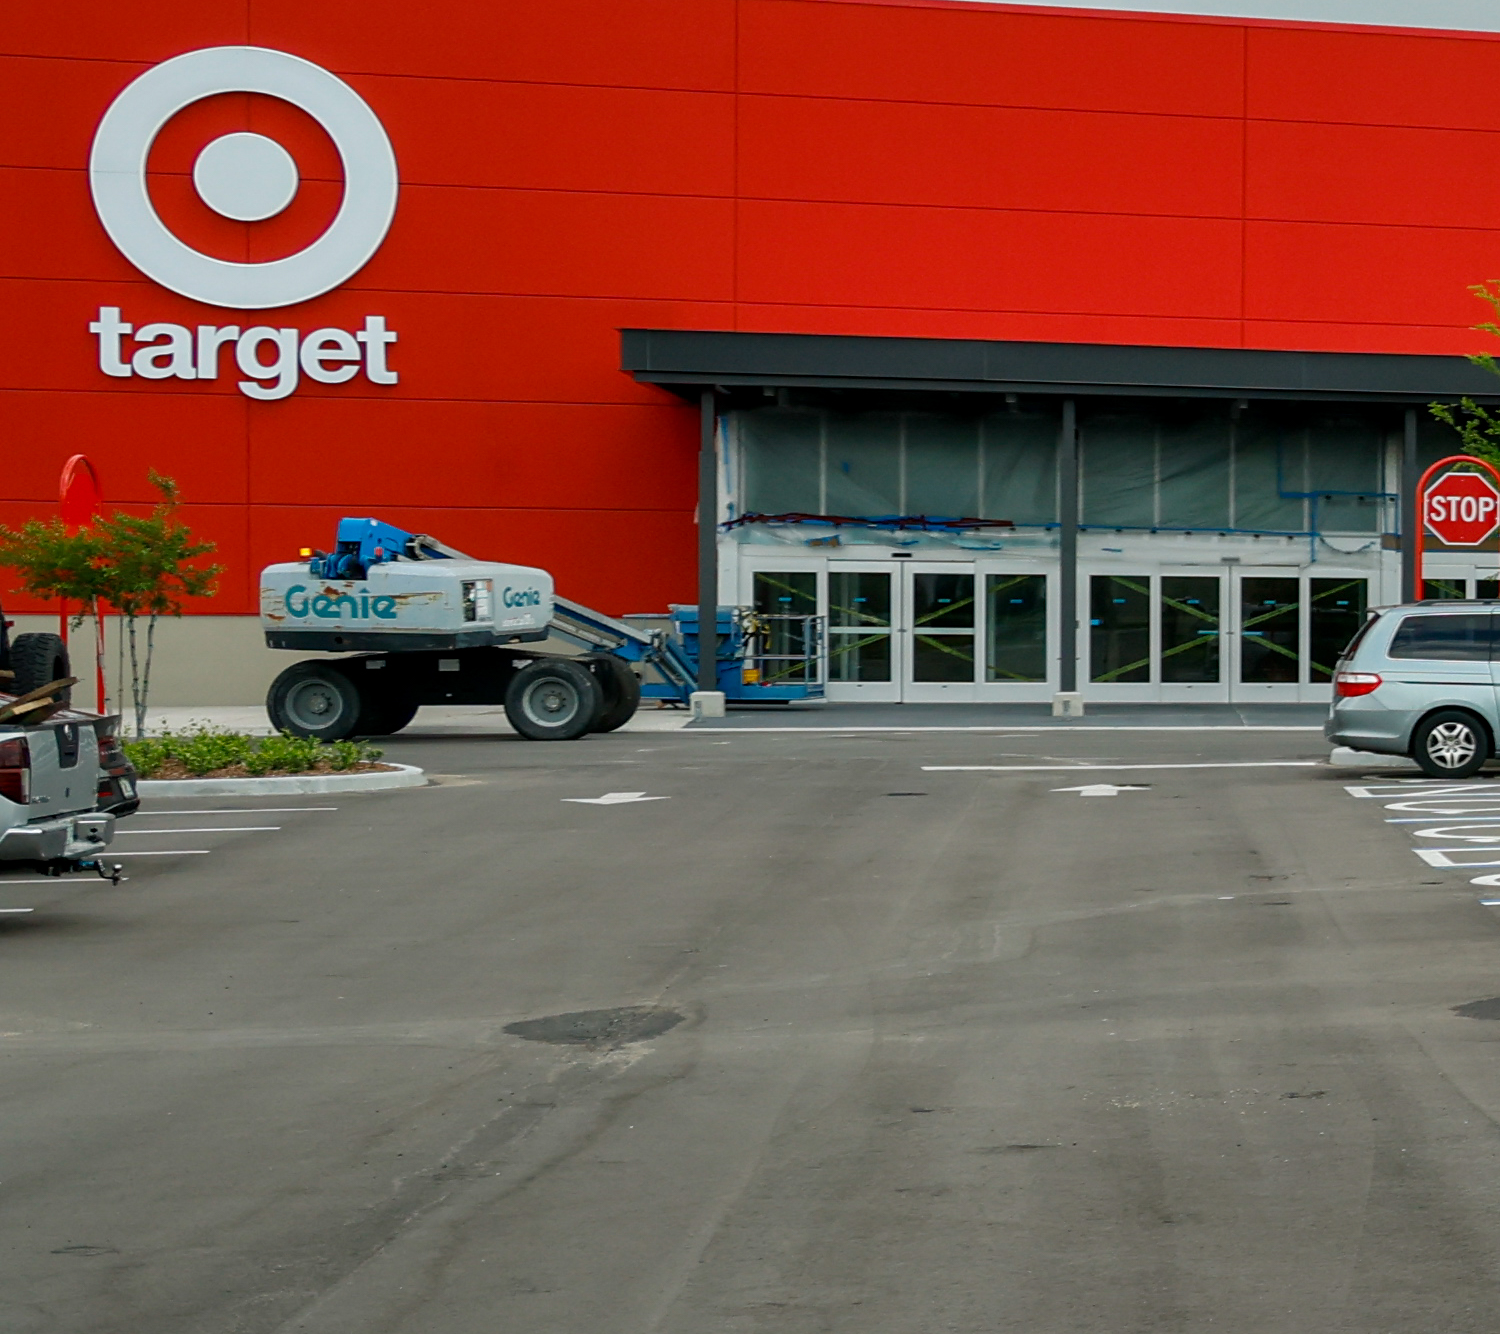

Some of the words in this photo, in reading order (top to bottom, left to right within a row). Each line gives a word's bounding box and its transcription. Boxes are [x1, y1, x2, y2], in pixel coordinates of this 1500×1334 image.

[89, 306, 399, 401] target
[1430, 495, 1495, 522] STOP
[285, 584, 397, 620] Genie
[503, 586, 541, 609] Genie
